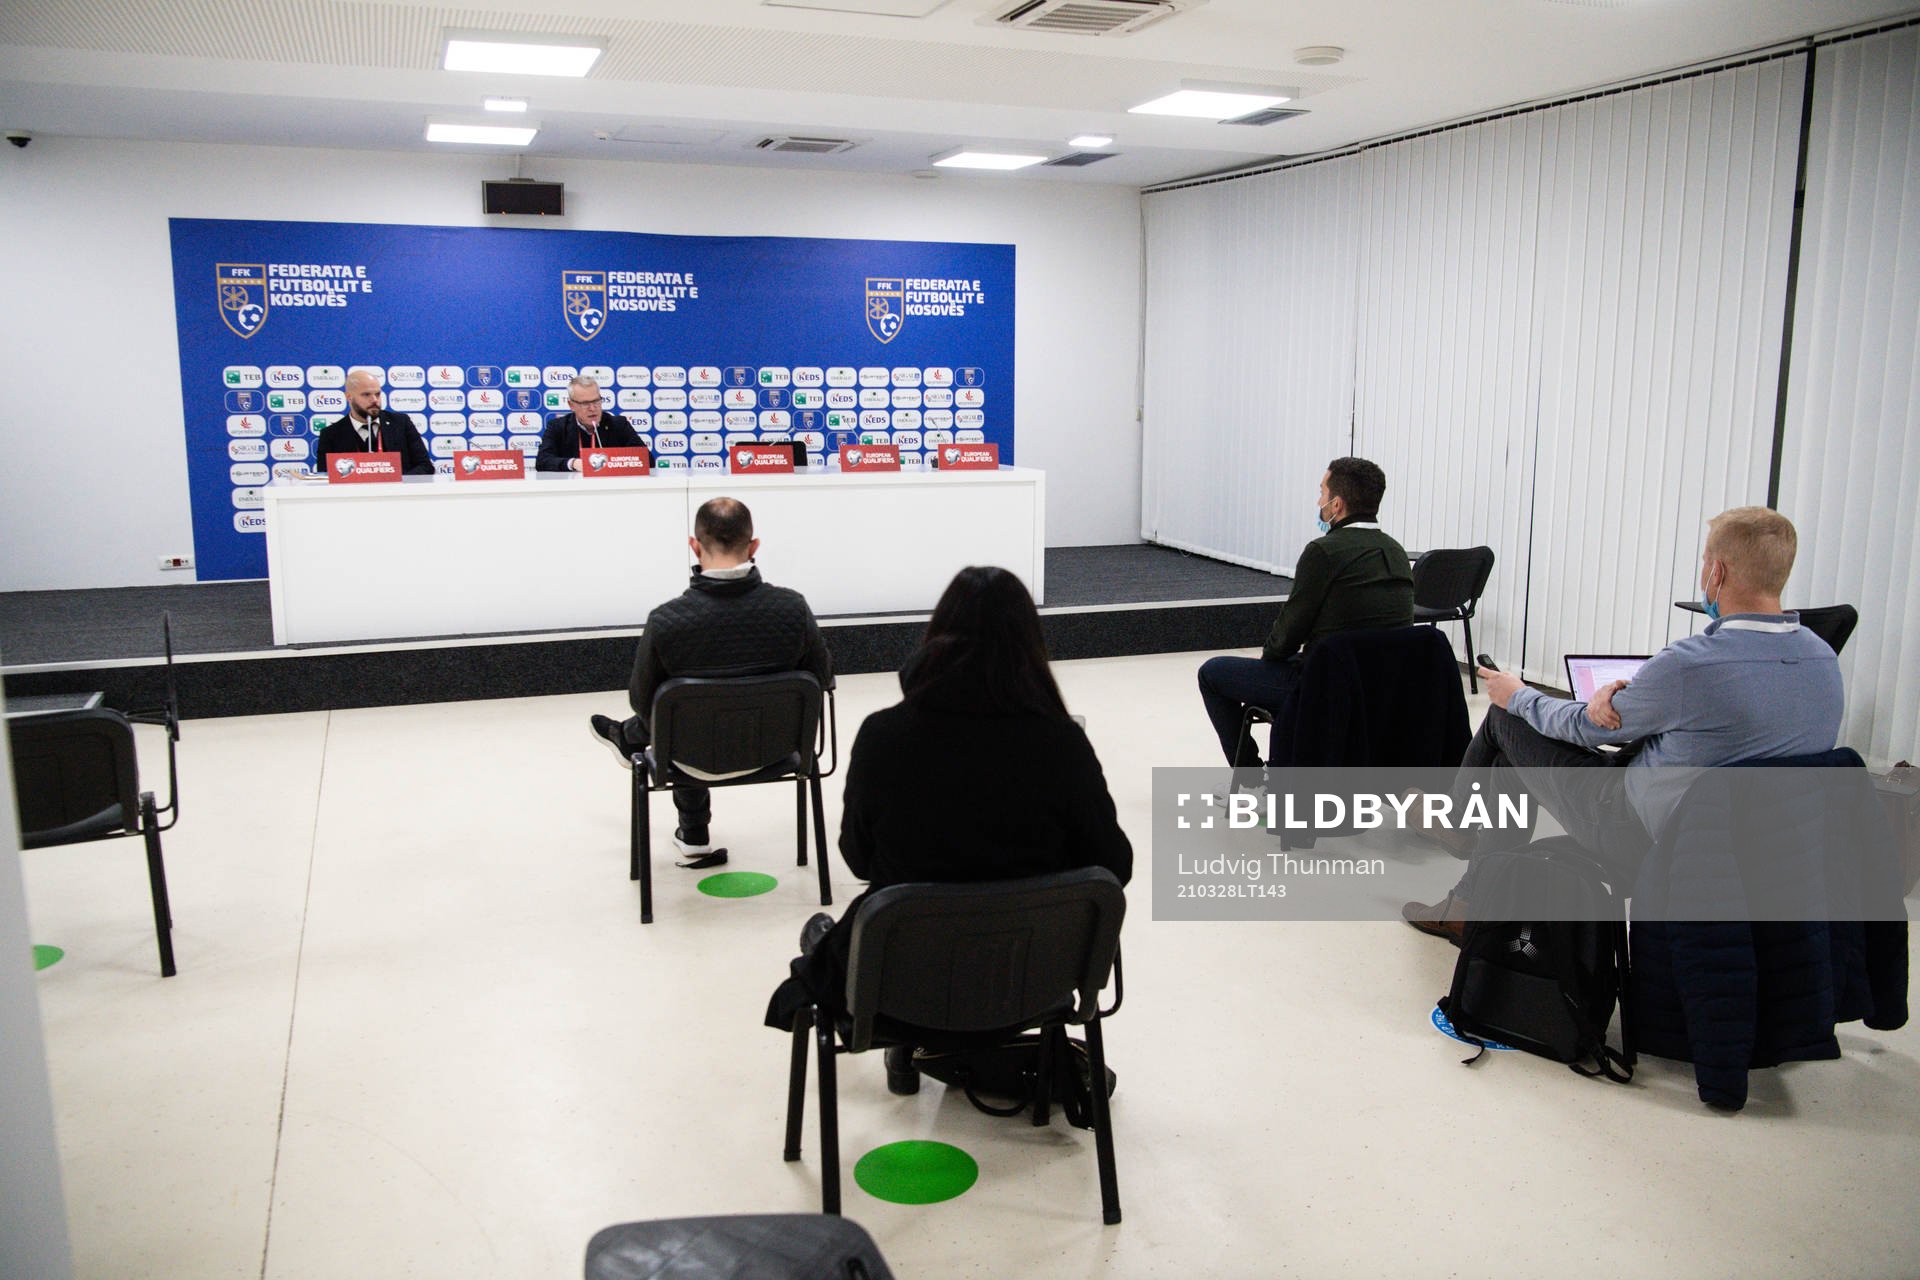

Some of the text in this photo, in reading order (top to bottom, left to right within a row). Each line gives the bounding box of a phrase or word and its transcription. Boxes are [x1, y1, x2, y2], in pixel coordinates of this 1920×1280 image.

[231, 268, 251, 277] FFK
[268, 263, 367, 278] FEDERATA E
[576, 275, 593, 284] FFK
[608, 271, 694, 285] FEDERATA E
[269, 279, 373, 293] FUTBOLLIT E
[877, 282, 892, 290] FFK
[905, 278, 981, 291] FEDERATA E
[608, 285, 699, 298] FUTBOLLIT E
[270, 291, 348, 307] KOSOVËS
[905, 292, 985, 304] FUTBOLLIT E
[609, 296, 676, 312] KOSOVËS
[905, 302, 965, 317] KOSOVËS
[273, 371, 300, 382] KEDS
[798, 371, 820, 381] KEDS
[316, 395, 342, 405] KEDS
[832, 394, 854, 403] KEDS
[865, 415, 886, 423] KEDS
[661, 438, 684, 448] KEDS
[898, 436, 919, 444] KEDS
[607, 461, 644, 469] QUALIFIERS
[863, 457, 895, 465] QUALIFIERS
[356, 467, 395, 475] QUALIFIERS
[480, 464, 518, 472] QUALIFIERS
